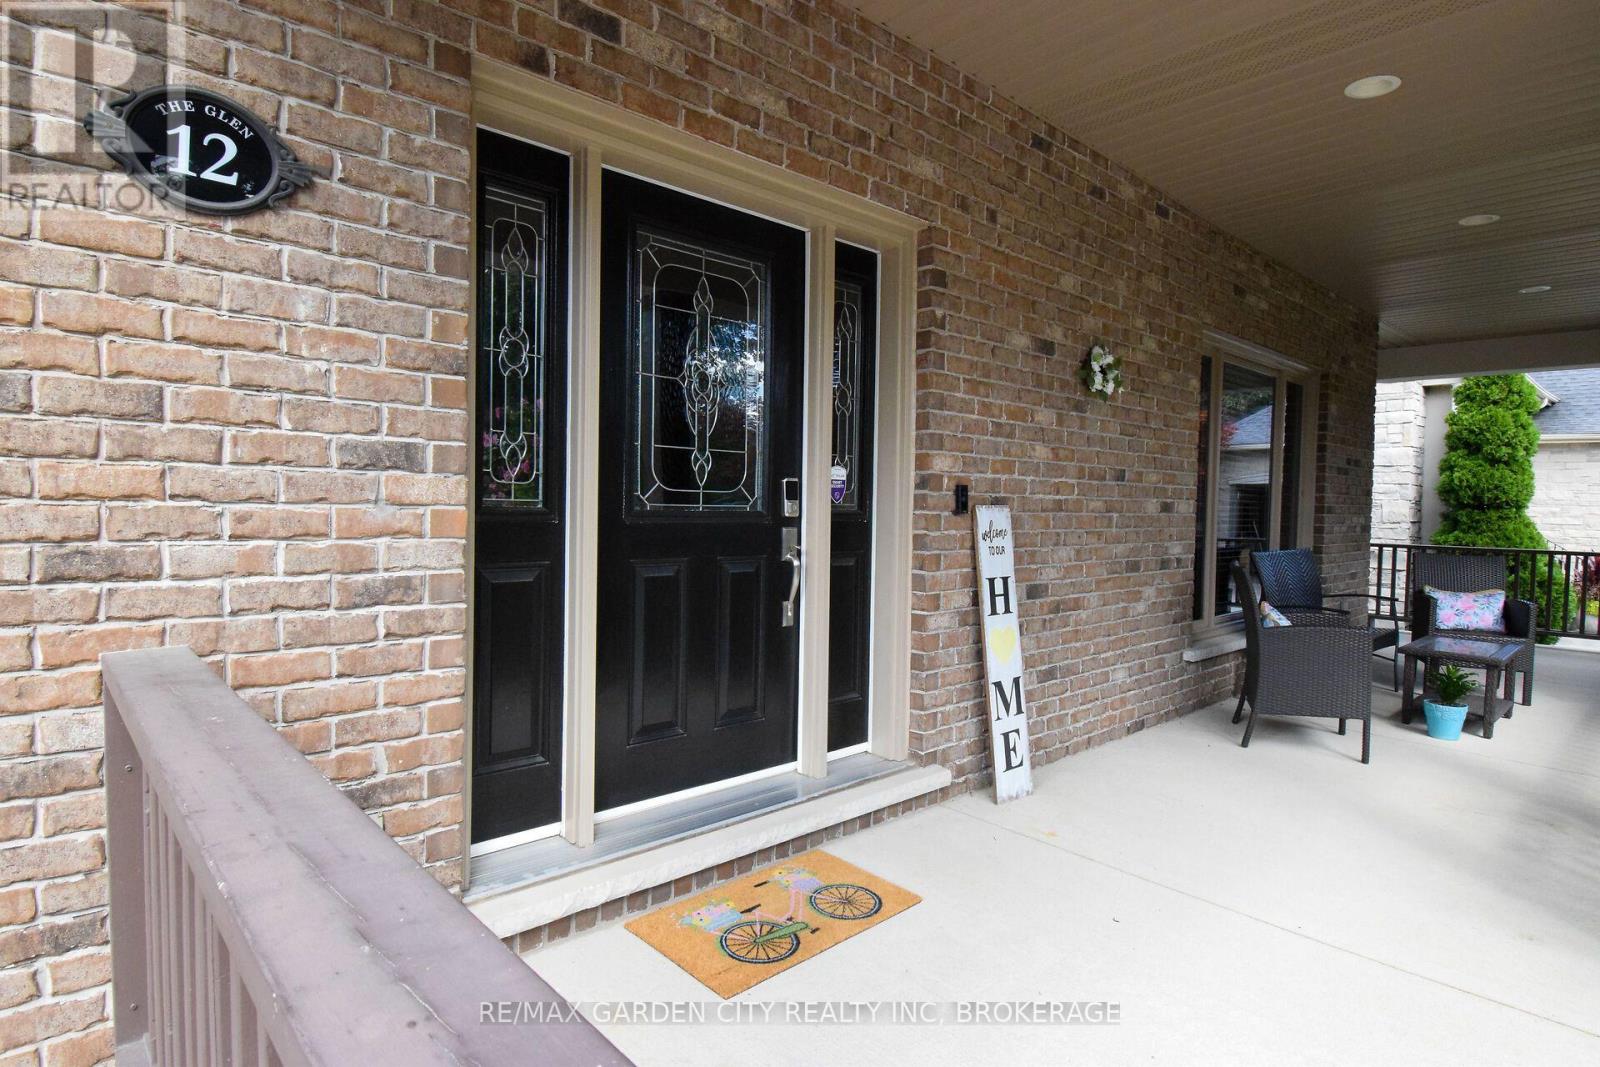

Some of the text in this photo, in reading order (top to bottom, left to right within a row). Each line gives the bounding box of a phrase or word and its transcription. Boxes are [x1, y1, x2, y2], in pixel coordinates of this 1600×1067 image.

[155, 100, 255, 140] THE GLEN
[166, 124, 238, 187] 12
[988, 545, 1006, 556] TO OUR
